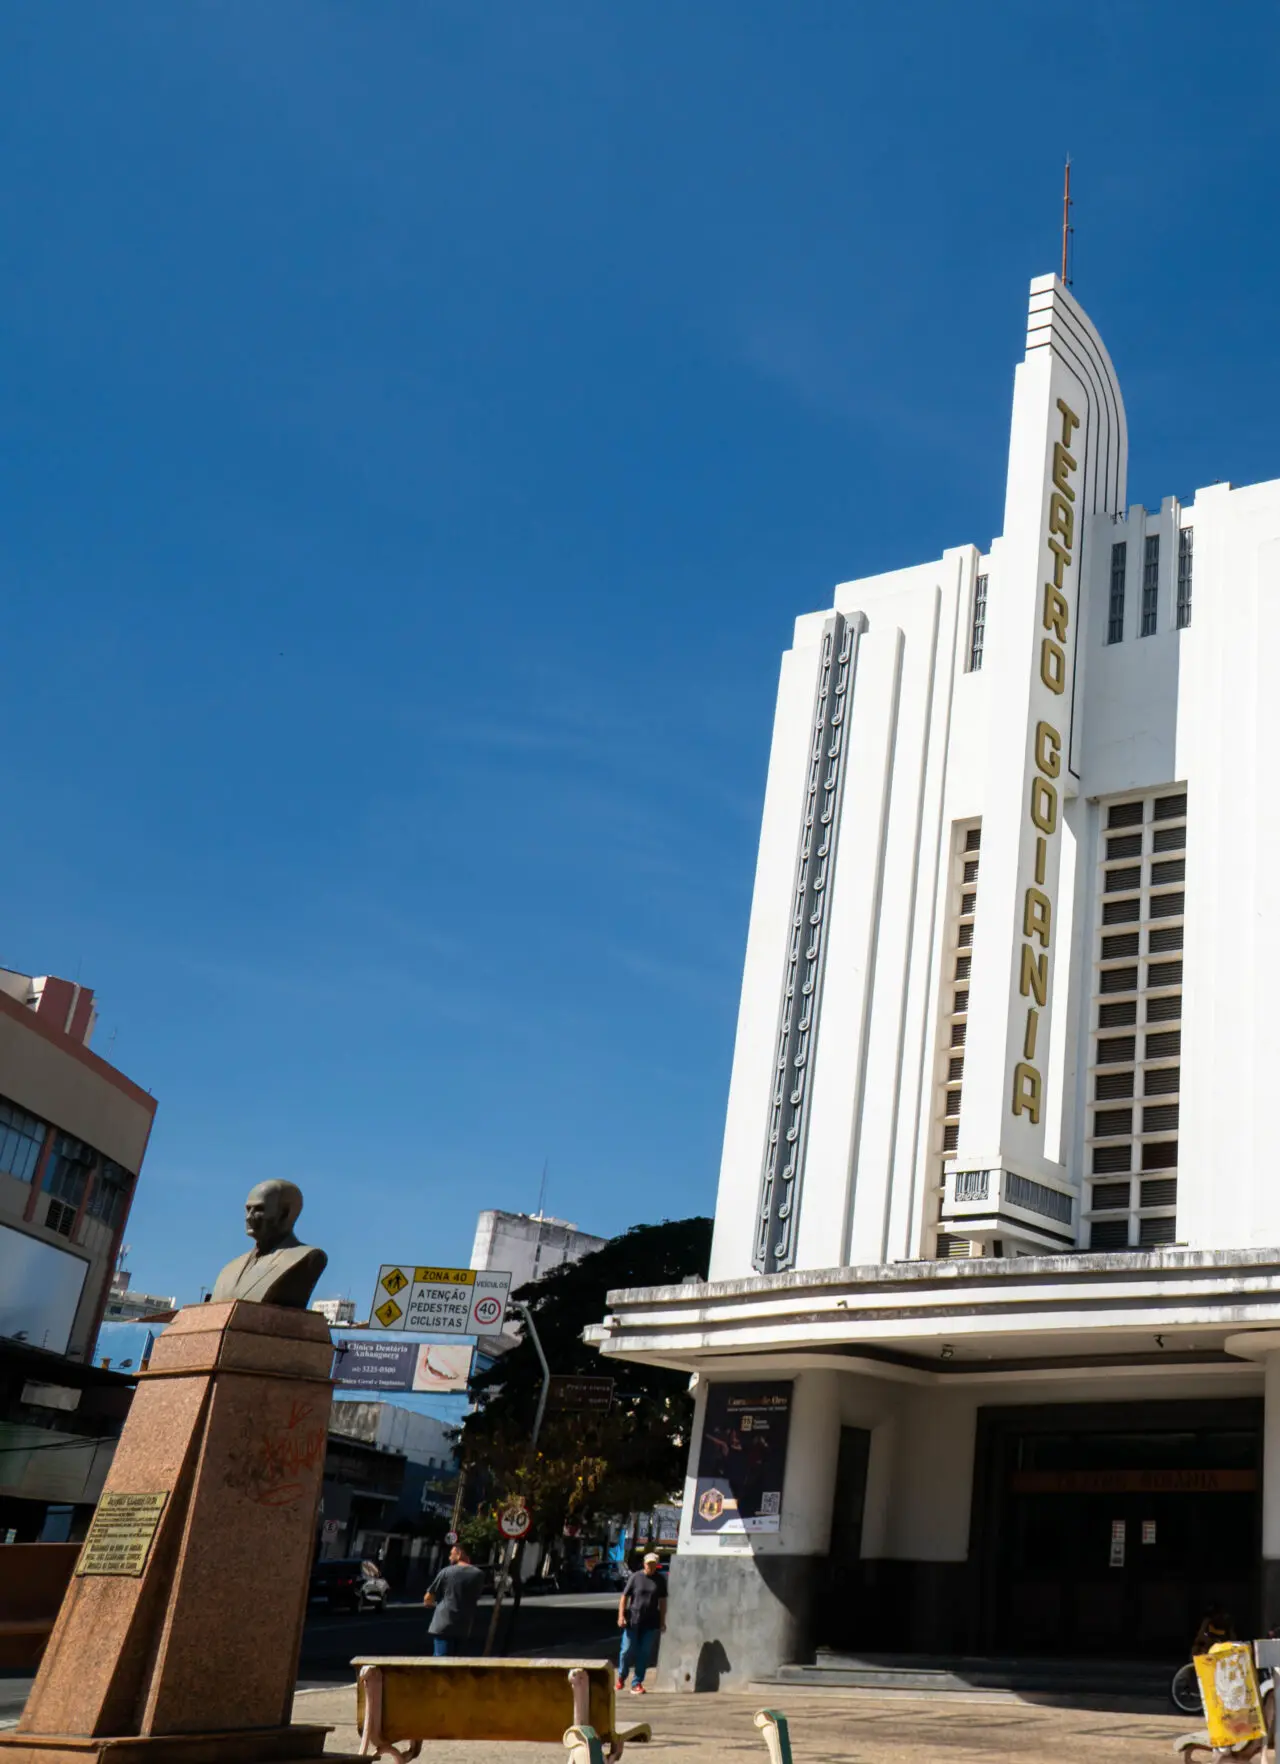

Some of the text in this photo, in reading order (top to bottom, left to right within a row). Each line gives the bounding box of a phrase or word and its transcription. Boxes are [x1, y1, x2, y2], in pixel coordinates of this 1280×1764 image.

[1040, 397, 1080, 696] TEATRO
[422, 1270, 468, 1282] ZONA 40
[417, 1288, 466, 1302] ATENÇÃO
[409, 1302, 468, 1314] PEDESTRES
[479, 1303, 497, 1315] 40
[410, 1315, 462, 1328] CICLISTAS
[347, 1342, 374, 1351] Clínica
[504, 1510, 527, 1527] 40
